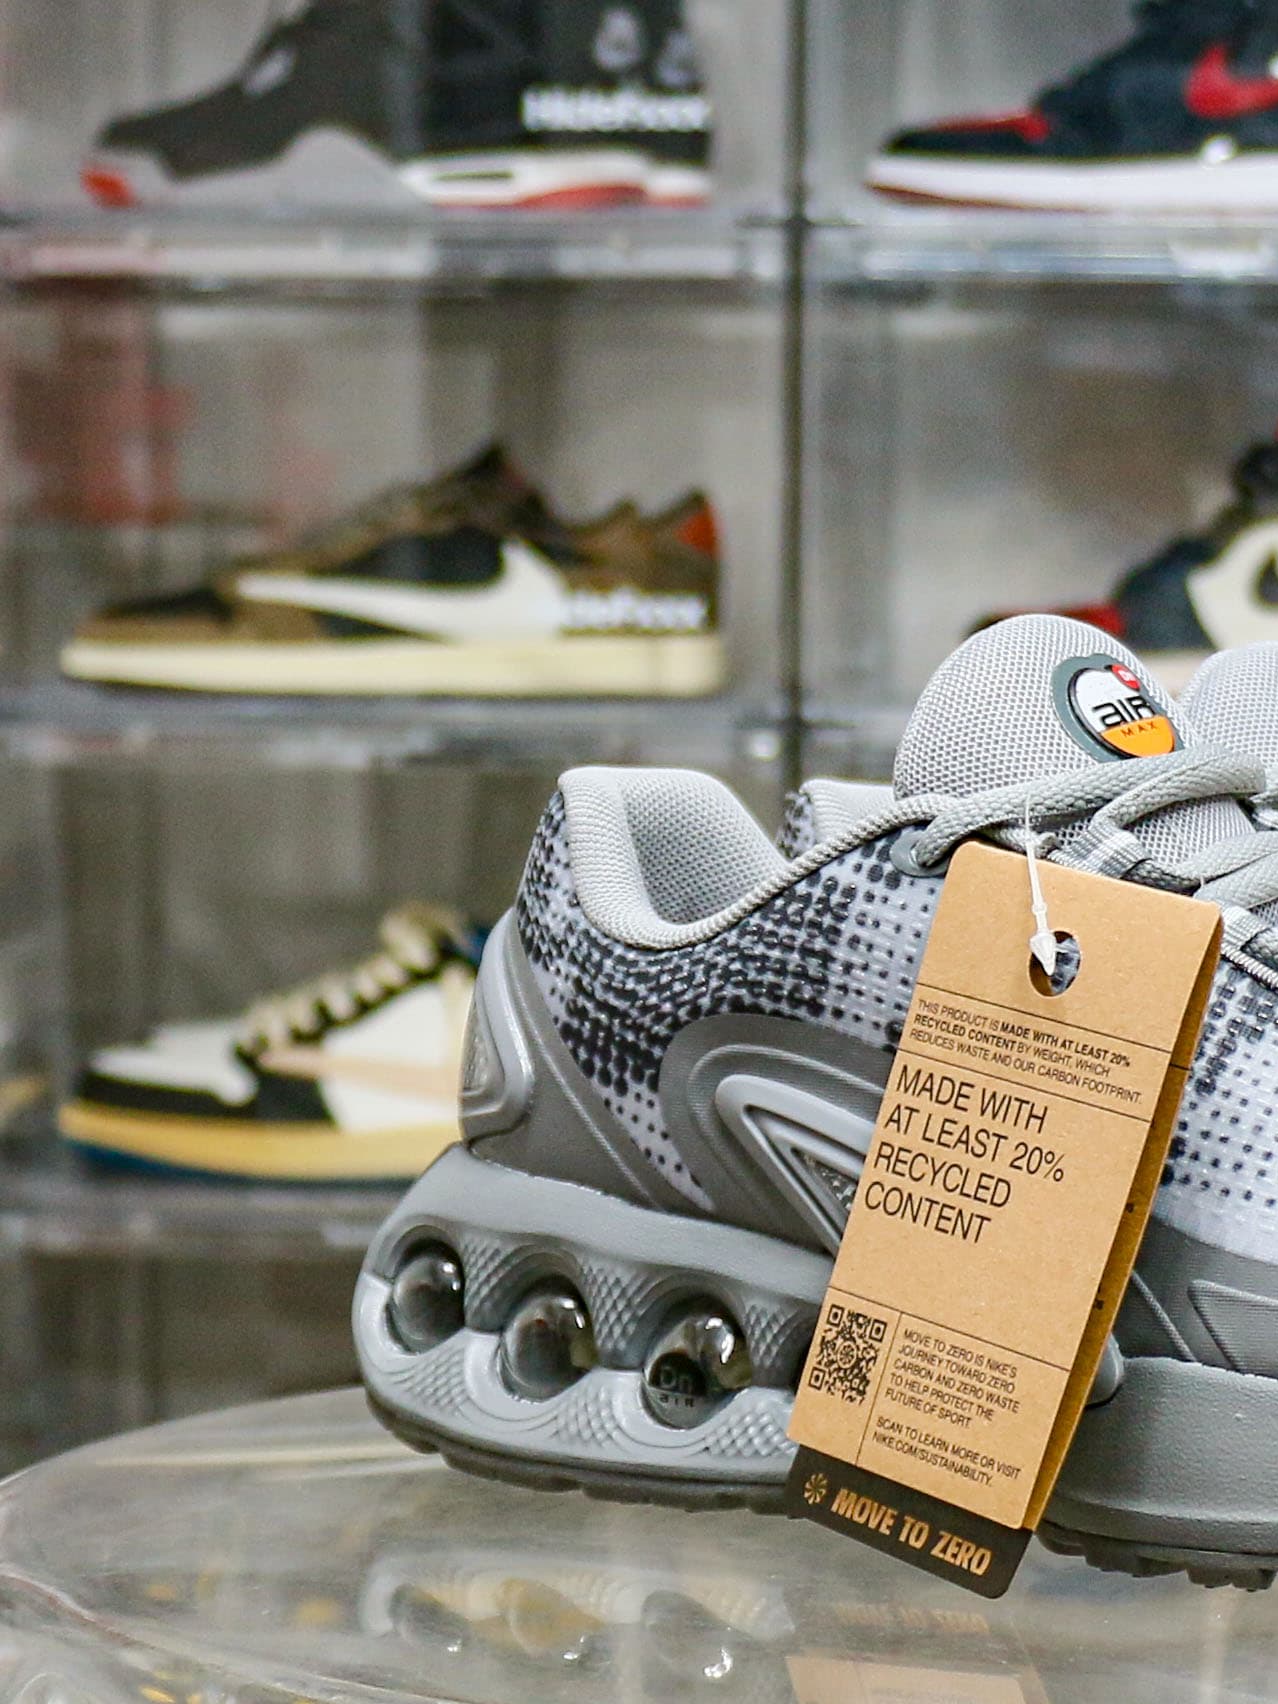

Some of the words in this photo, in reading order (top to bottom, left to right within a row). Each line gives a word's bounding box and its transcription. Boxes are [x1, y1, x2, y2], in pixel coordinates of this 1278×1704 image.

[1120, 721, 1157, 737] MAX
[910, 1028, 956, 1051] REDUCES
[957, 1043, 991, 1062] WASTE
[991, 1052, 1012, 1067] AND
[1013, 1058, 1036, 1074] OUR
[1038, 1065, 1081, 1087] CARBON
[914, 1014, 966, 1037] RECYCLED
[968, 1029, 1017, 1052] CONTENT
[1017, 1042, 1032, 1054] BY
[1076, 1059, 1111, 1078] WHICH
[919, 999, 940, 1015] THIS
[941, 1005, 989, 1028] PRODUCT
[990, 1019, 1000, 1032] IS
[1000, 1022, 1031, 1040] MADE
[1033, 1031, 1059, 1047] WITH
[1060, 1039, 1075, 1051] AT
[1075, 1043, 1110, 1061] LEAST
[1110, 1053, 1131, 1068] 20%
[897, 1065, 976, 1113] MADE
[980, 1088, 1048, 1134] WITH
[874, 1141, 1012, 1208] RECYCLED
[884, 1104, 921, 1135] AT
[922, 1114, 1009, 1163] LEAST
[1009, 1142, 1065, 1183] 20%
[865, 1181, 992, 1244] CONTENT
[899, 1345, 945, 1368] JOURNEY
[946, 1360, 987, 1384] TOWARD
[987, 1375, 1016, 1395] ZERO
[904, 1329, 932, 1348] MOVE
[933, 1339, 947, 1353] TO
[947, 1344, 974, 1363] ZERO
[974, 1354, 985, 1368] IS
[885, 1388, 924, 1412] FUTURE
[923, 1402, 939, 1415] OF
[891, 1373, 904, 1387] TO
[904, 1379, 930, 1395] HELP
[930, 1388, 975, 1413] PROTECT
[976, 1405, 995, 1422] THE
[894, 1358, 935, 1382] CARBON
[935, 1374, 956, 1390] AND
[956, 1381, 985, 1400] ZERO
[986, 1392, 1021, 1414] WASTE
[877, 1416, 904, 1435] SCAN
[906, 1427, 918, 1441] TO
[918, 1433, 950, 1453] LEARN
[951, 1445, 981, 1465] MORE
[980, 1456, 996, 1471] OR
[997, 1462, 1022, 1480] VISIT
[831, 1489, 898, 1536] MOVE
[900, 1517, 929, 1549] TO
[931, 1532, 991, 1576] ZERO
